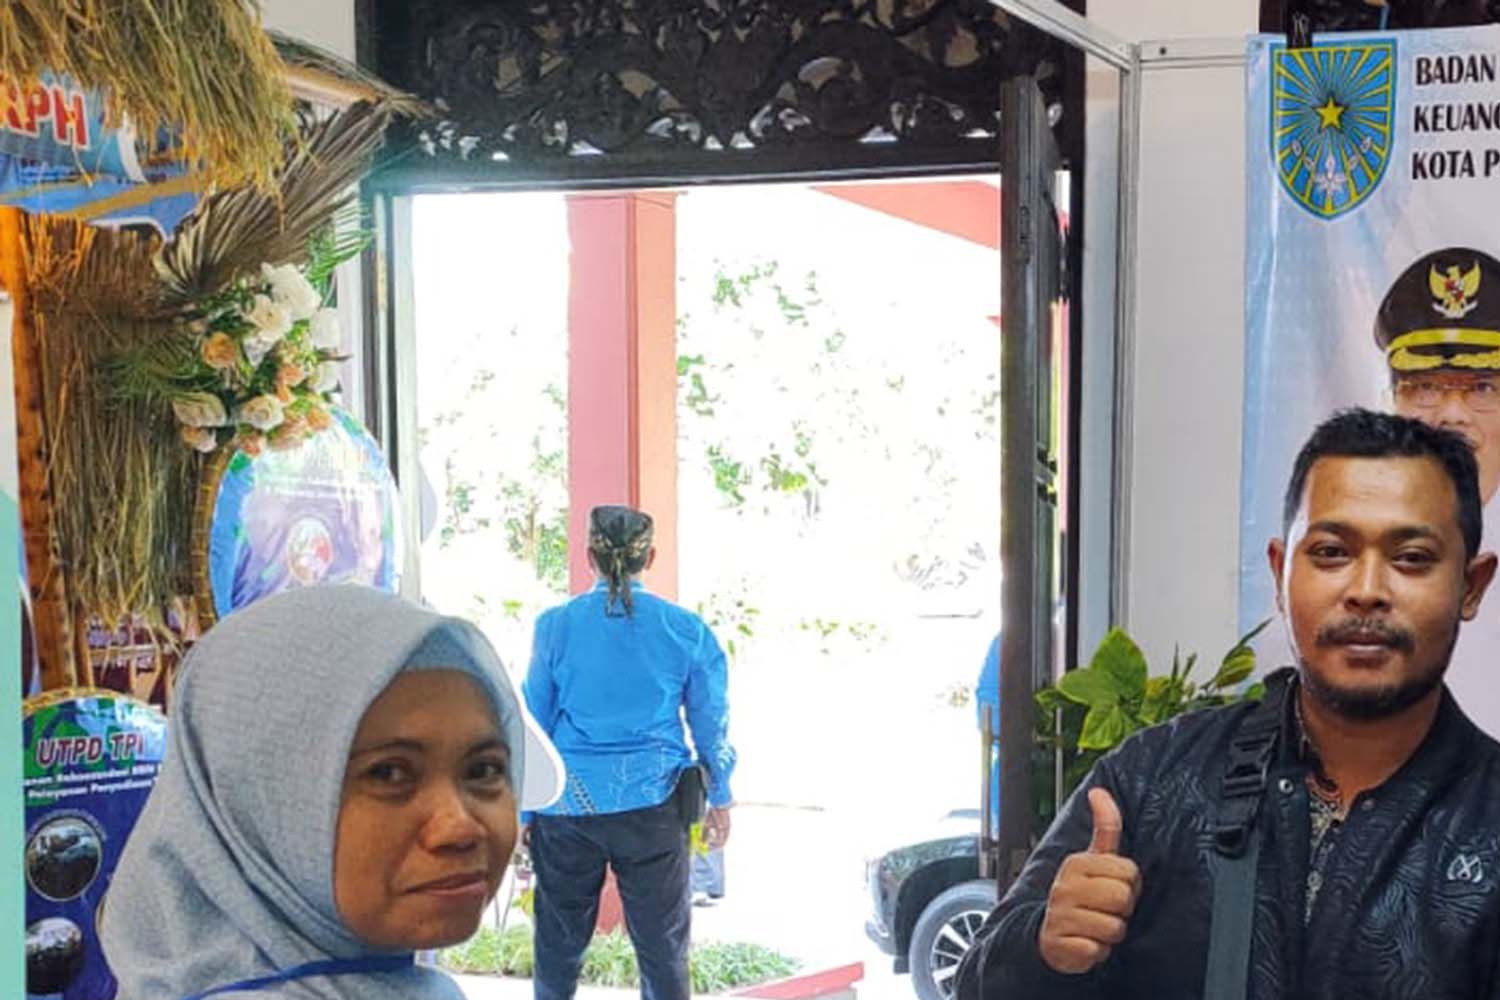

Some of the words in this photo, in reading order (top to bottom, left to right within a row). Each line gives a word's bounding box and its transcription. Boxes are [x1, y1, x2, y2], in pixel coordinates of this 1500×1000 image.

[1416, 54, 1496, 85] BADAN
[1411, 150, 1476, 180] KOTA
[37, 738, 103, 767] UTPD
